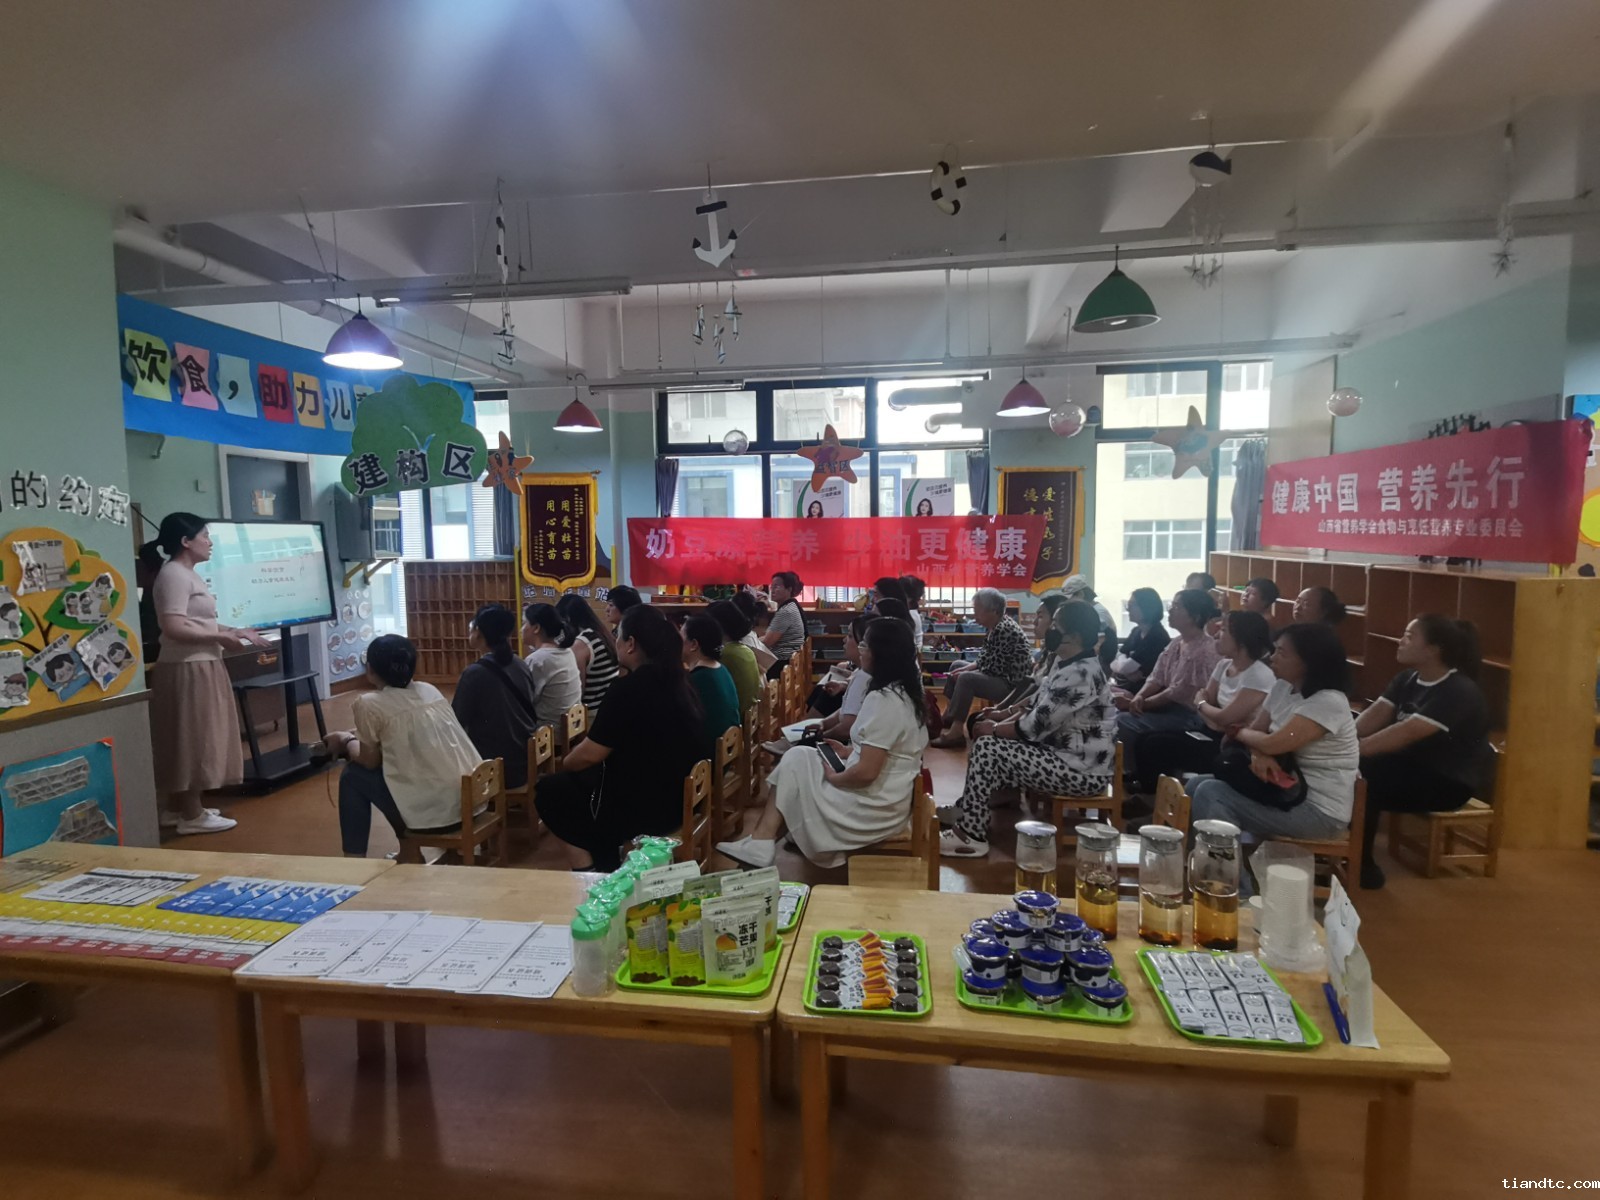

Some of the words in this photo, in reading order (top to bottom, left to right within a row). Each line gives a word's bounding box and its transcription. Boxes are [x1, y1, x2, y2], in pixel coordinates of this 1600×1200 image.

[0, 470, 130, 525] 的约定
[348, 443, 476, 495] 建构区
[1271, 473, 1359, 515] 健康中国
[1377, 456, 1525, 512] 营养先行
[546, 500, 557, 560] 用心育苗
[561, 500, 572, 560] 用爱壮苗
[1318, 517, 1523, 538] 山西省营养学会食物与烹饪营养专业委员会
